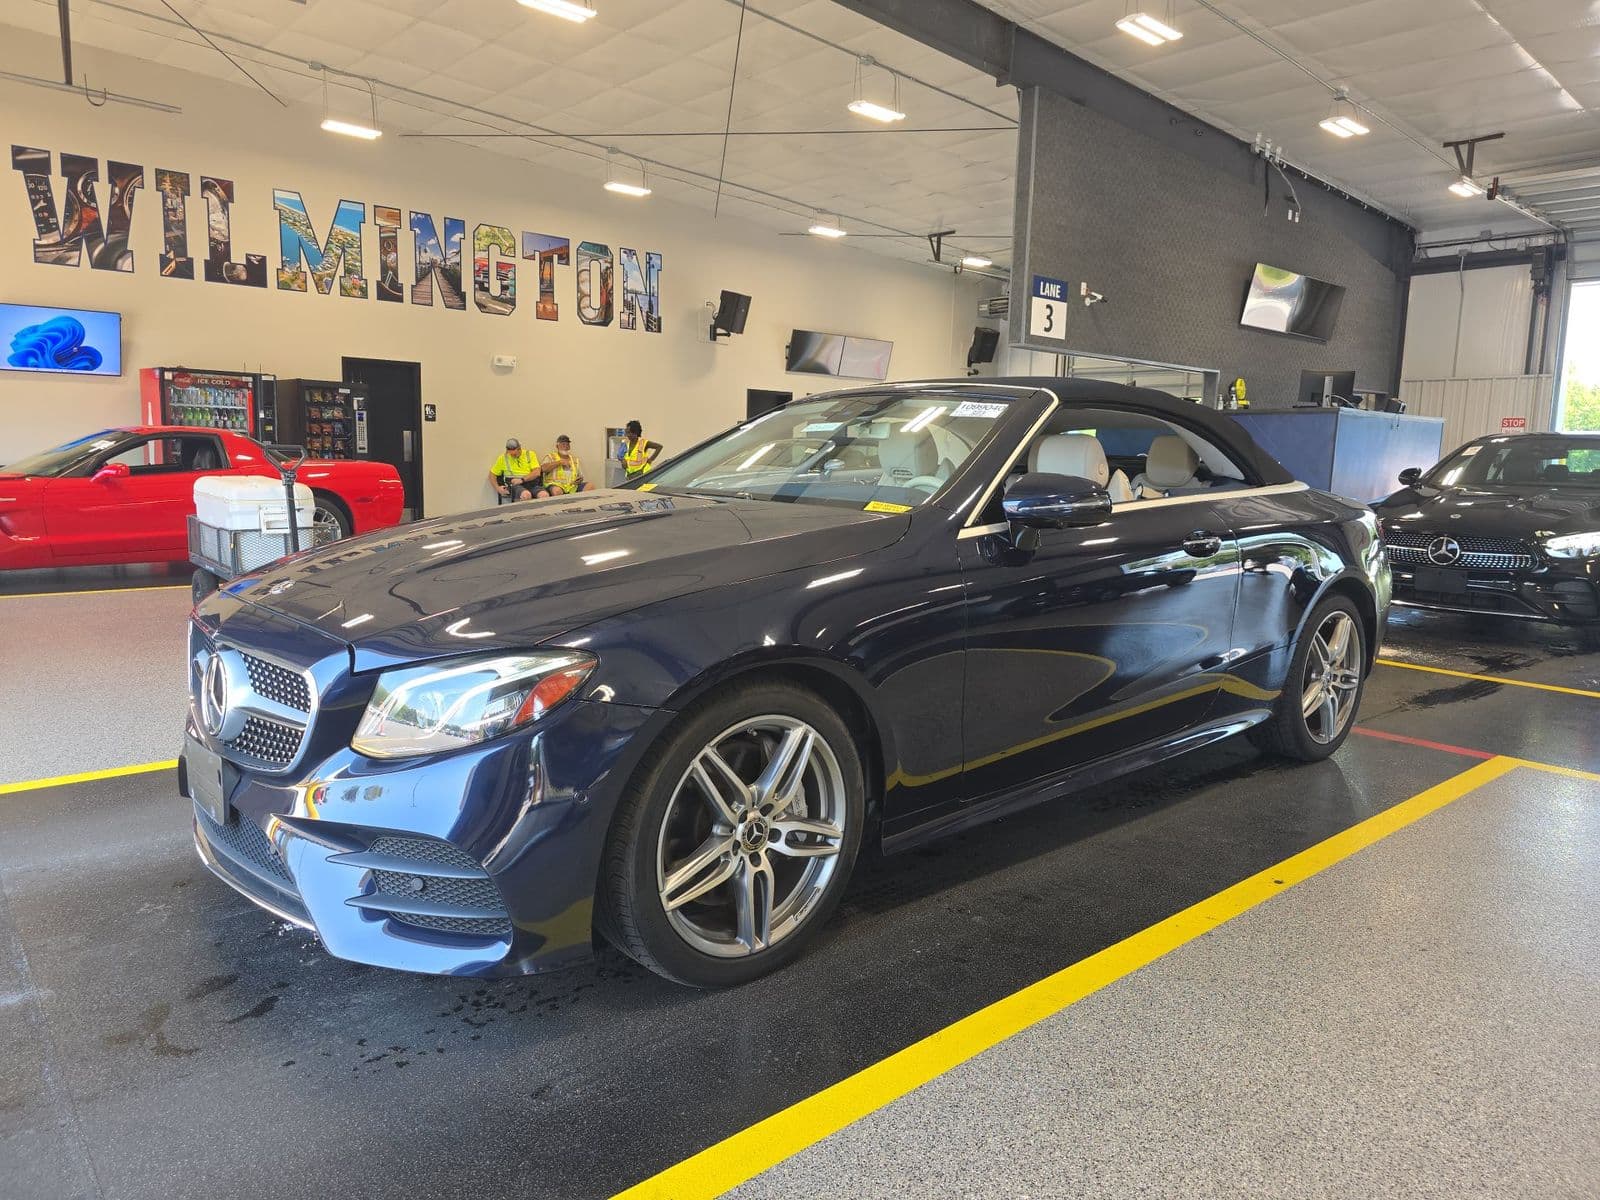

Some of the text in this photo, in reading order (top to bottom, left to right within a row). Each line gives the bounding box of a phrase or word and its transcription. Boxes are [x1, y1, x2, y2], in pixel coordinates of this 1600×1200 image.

[11, 145, 662, 333] WILMINGTON
[1039, 281, 1061, 299] LANE
[1043, 303, 1054, 333] 3
[1503, 419, 1525, 427] STOP
